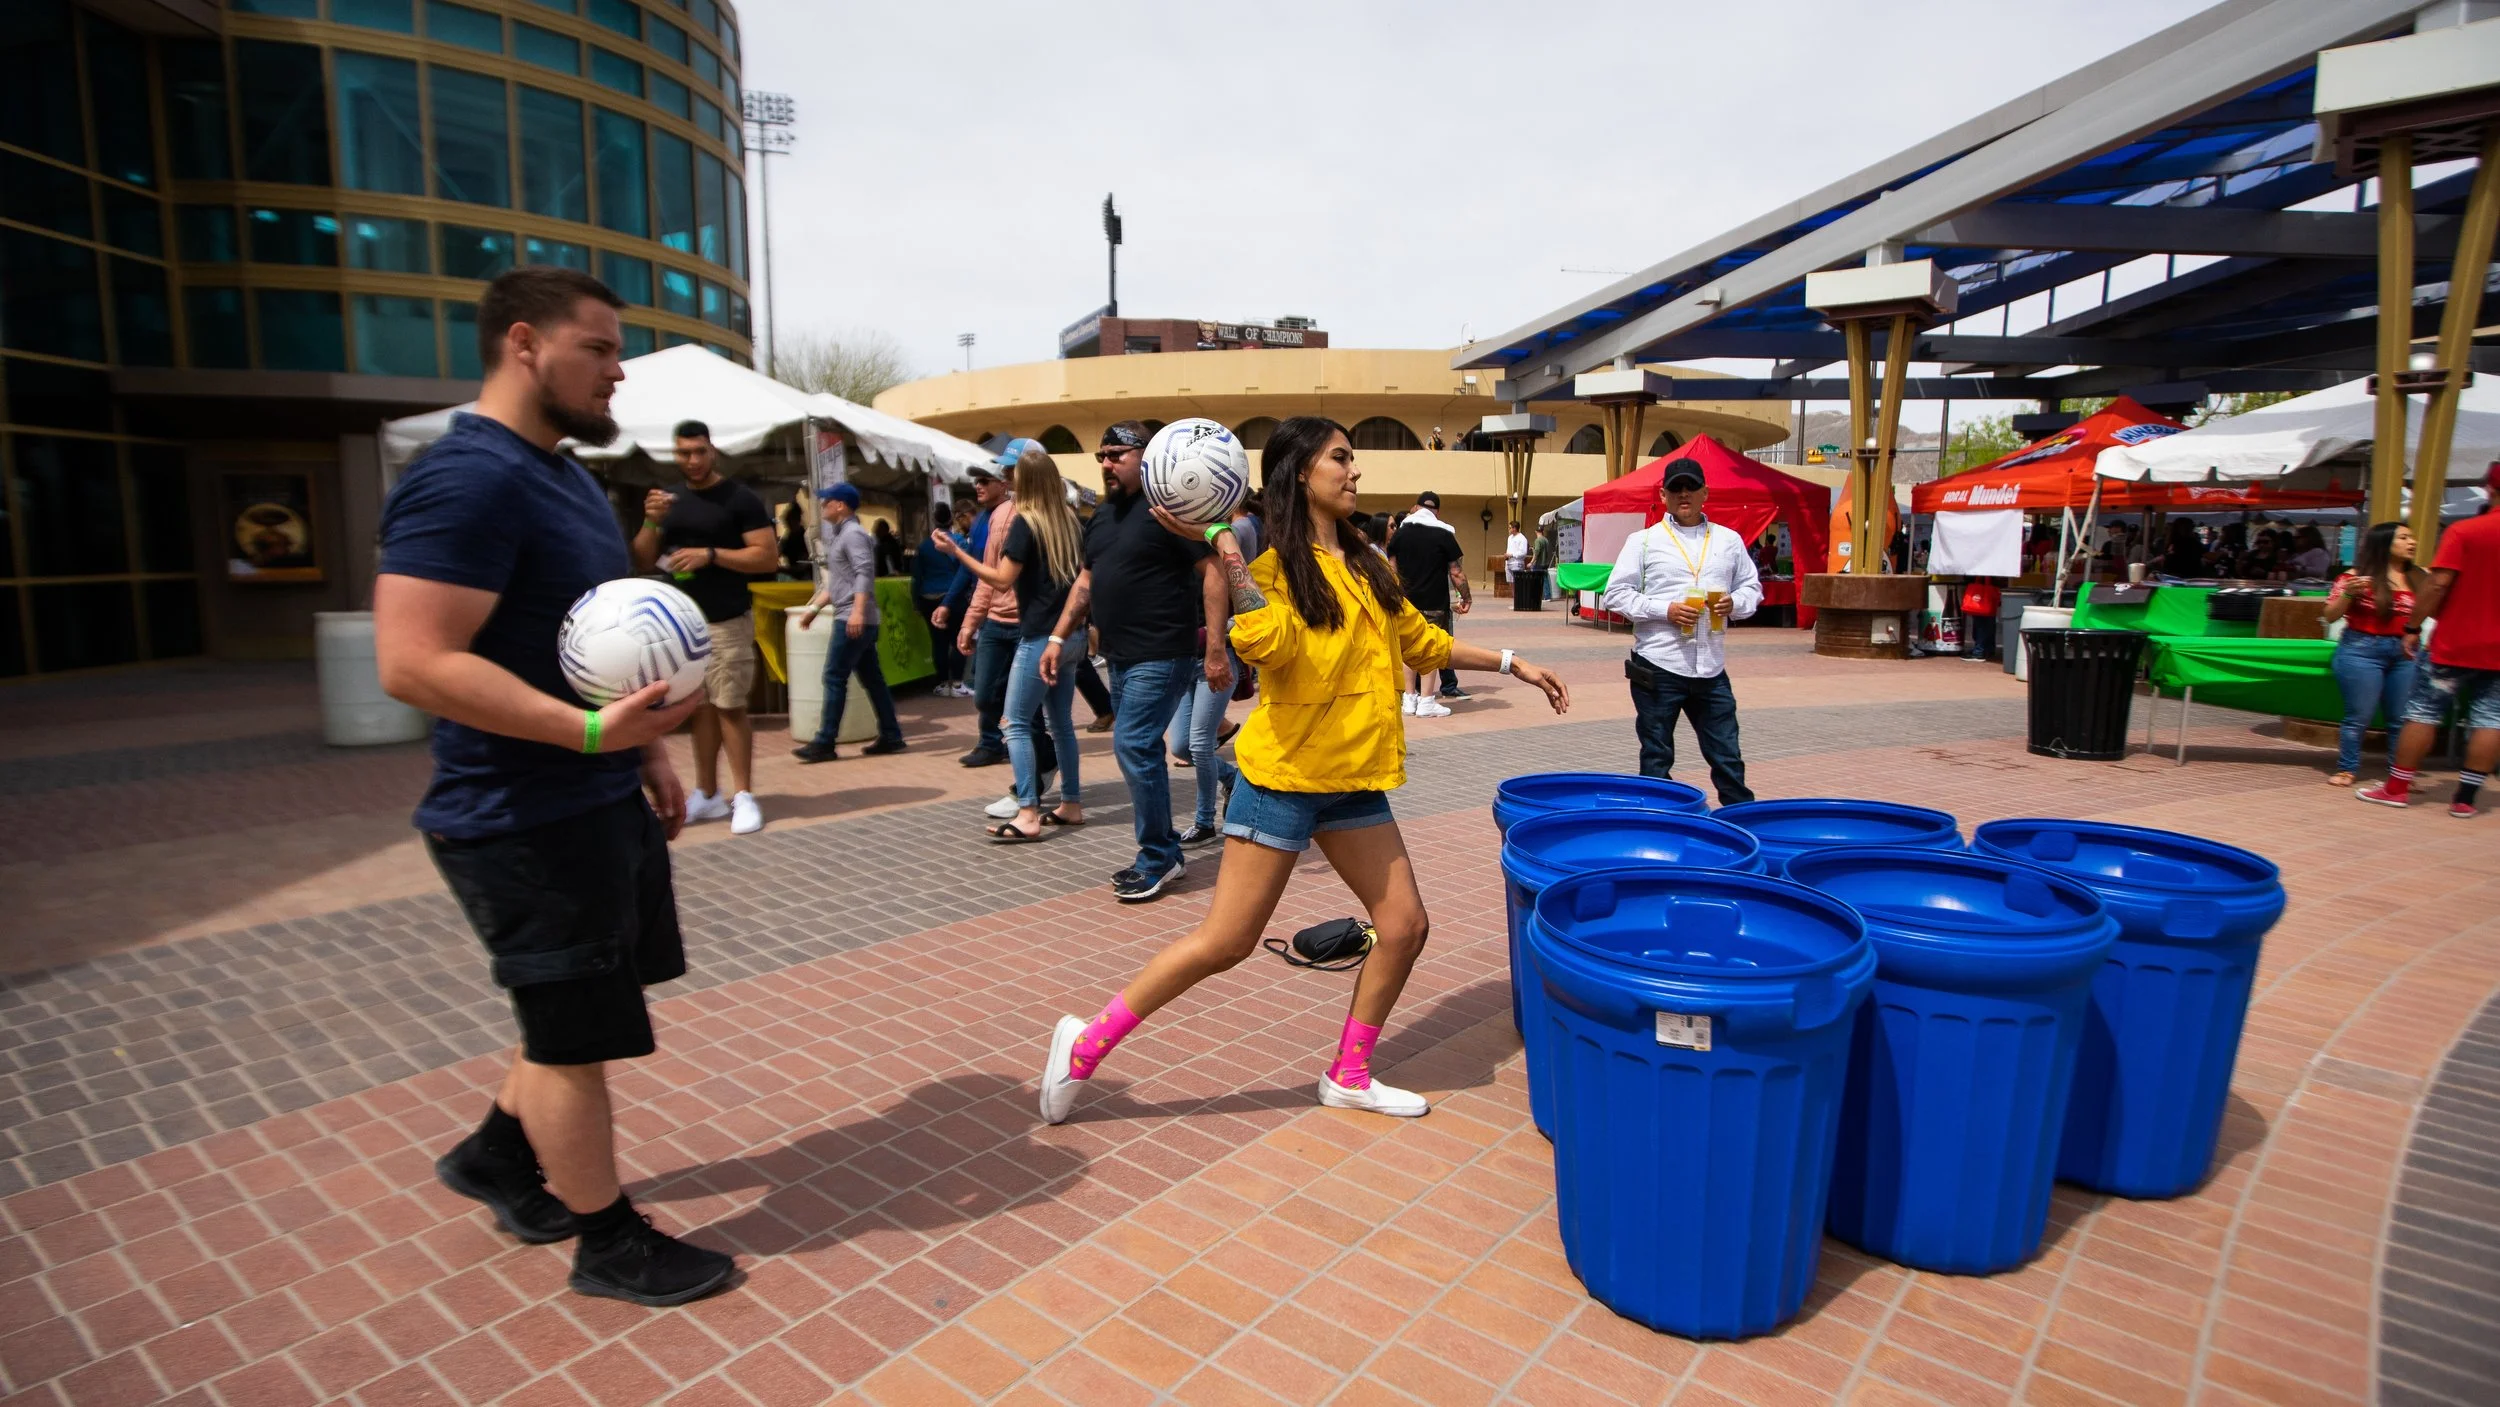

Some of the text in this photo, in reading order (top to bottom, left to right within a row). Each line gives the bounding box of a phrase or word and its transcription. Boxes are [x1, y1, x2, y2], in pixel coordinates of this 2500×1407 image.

[1217, 326, 1303, 344] WALL OF CHAMPIONS
[1186, 429, 1221, 448] BRAVA
[1968, 483, 2020, 505] Mundet
